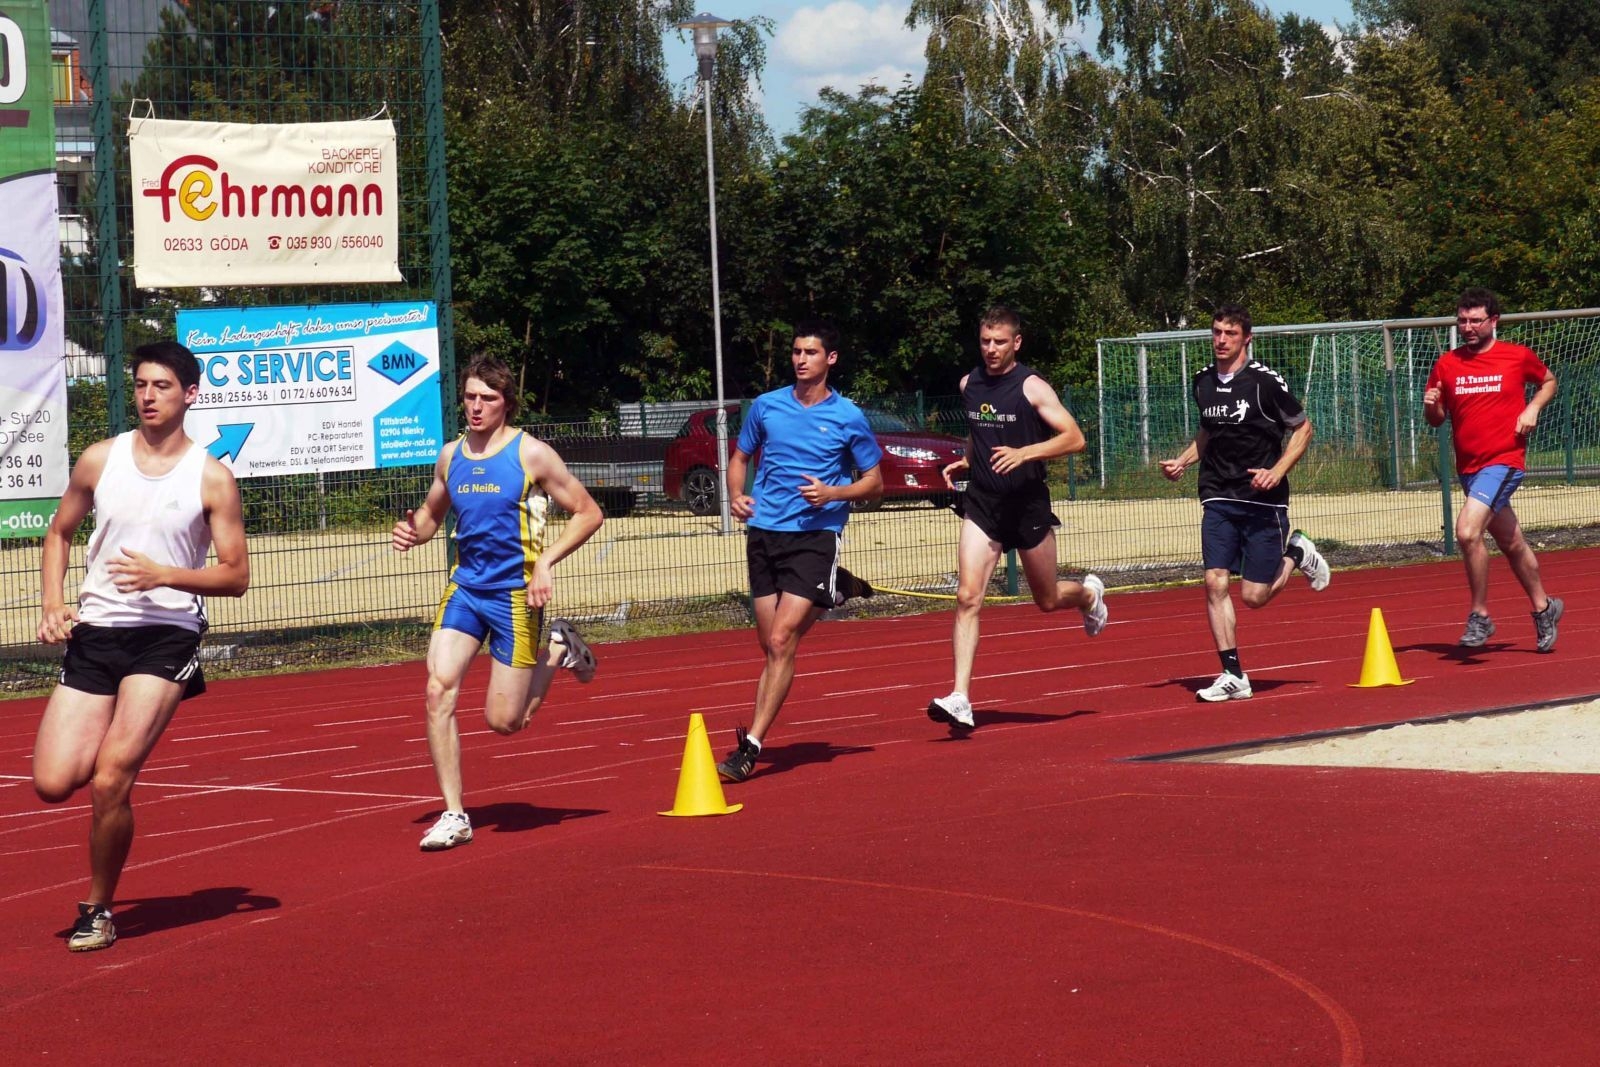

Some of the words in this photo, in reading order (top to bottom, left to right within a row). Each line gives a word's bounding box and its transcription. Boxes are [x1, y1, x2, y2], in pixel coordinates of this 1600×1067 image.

[308, 161, 382, 174] KONDITOREI
[163, 237, 204, 251] 02633
[186, 329, 217, 349] Kein
[302, 317, 333, 335] daher
[335, 318, 363, 332] umso
[237, 350, 352, 386] SERVICE
[381, 352, 416, 371] BMN
[1455, 383, 1502, 395] Silvesterlauf
[192, 390, 268, 405] 3588/2556-36
[35, 409, 51, 424] 20
[322, 421, 336, 430] EDV
[338, 419, 363, 429] Handel
[402, 425, 425, 436] Niesky
[308, 431, 364, 441] PC-Reparaturen
[290, 446, 305, 455] EDV
[307, 445, 321, 454] VOR
[323, 444, 337, 453] ORT
[338, 443, 364, 452] Service
[6, 455, 23, 469] 36
[27, 454, 43, 468] 40
[290, 458, 302, 467] DSL
[310, 455, 364, 465] Telefonanlagen
[7, 474, 24, 488] 36
[28, 473, 42, 487] 41
[457, 484, 469, 494] LG
[472, 483, 500, 493] Neiße
